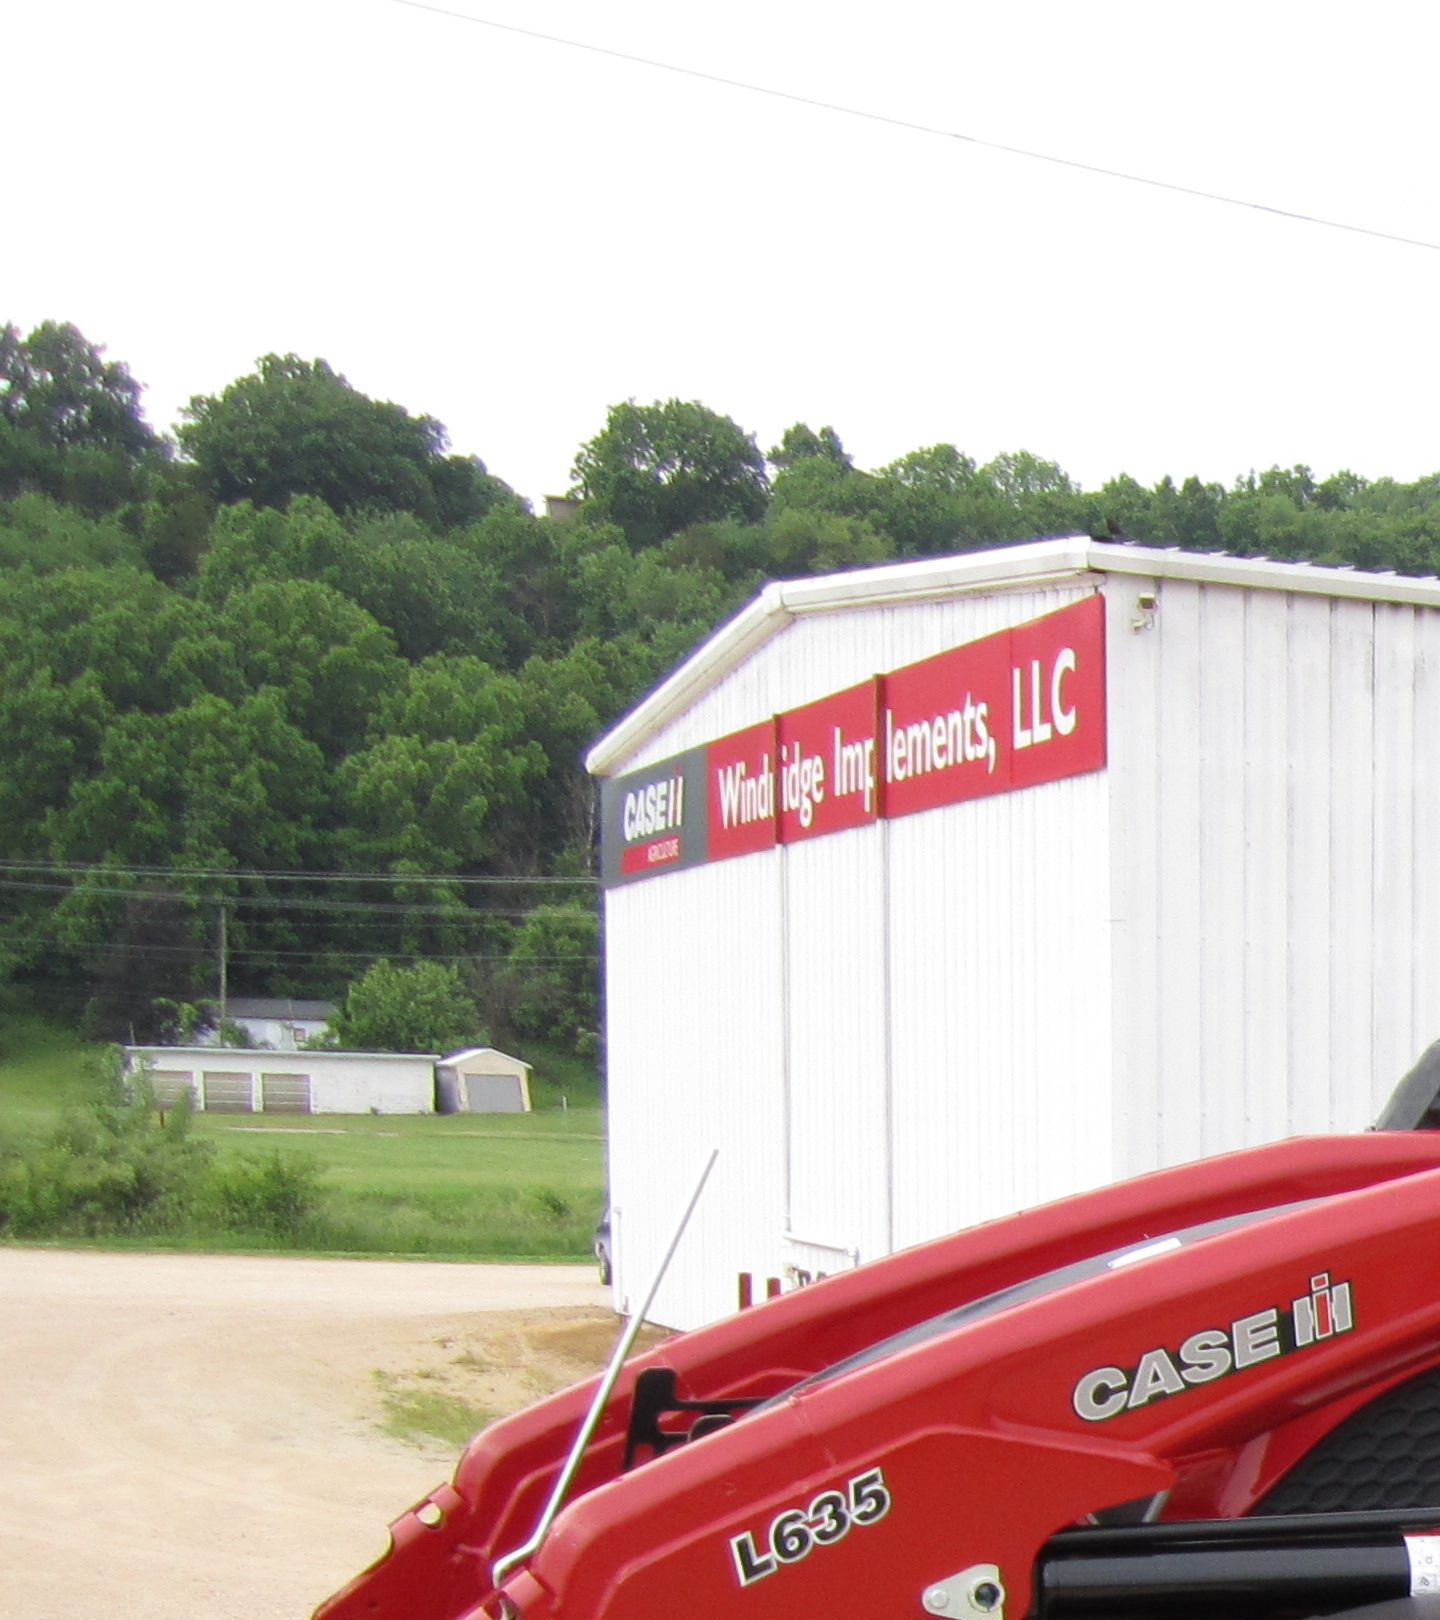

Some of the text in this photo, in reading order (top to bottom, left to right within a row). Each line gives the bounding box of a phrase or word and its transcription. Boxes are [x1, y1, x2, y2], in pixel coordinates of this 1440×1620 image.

[1013, 648, 1077, 750] LLC
[624, 780, 668, 842] CASE
[1073, 1271, 1354, 1422] CASE IH
[729, 1466, 892, 1588] L635
